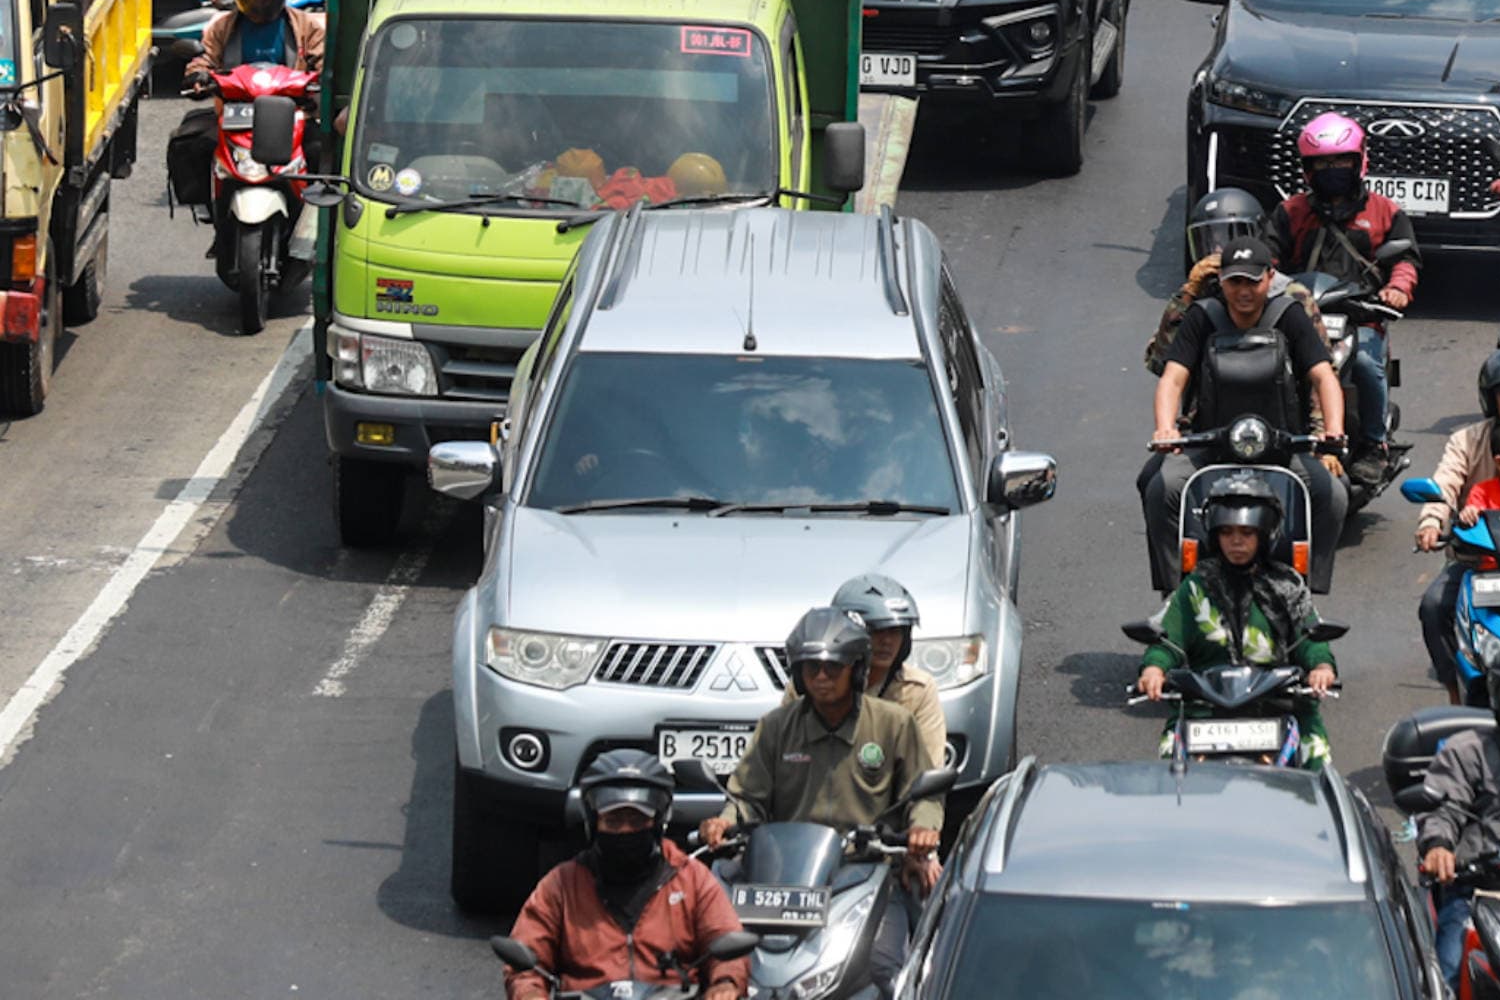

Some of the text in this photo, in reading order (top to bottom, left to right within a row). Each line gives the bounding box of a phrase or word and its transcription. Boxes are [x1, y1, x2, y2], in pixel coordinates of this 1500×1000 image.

[880, 57, 911, 75] VJD
[1412, 181, 1446, 201] CIR
[376, 301, 439, 316] HINO
[663, 734, 747, 759] B 2518
[737, 889, 747, 905] B
[754, 890, 791, 907] 5267
